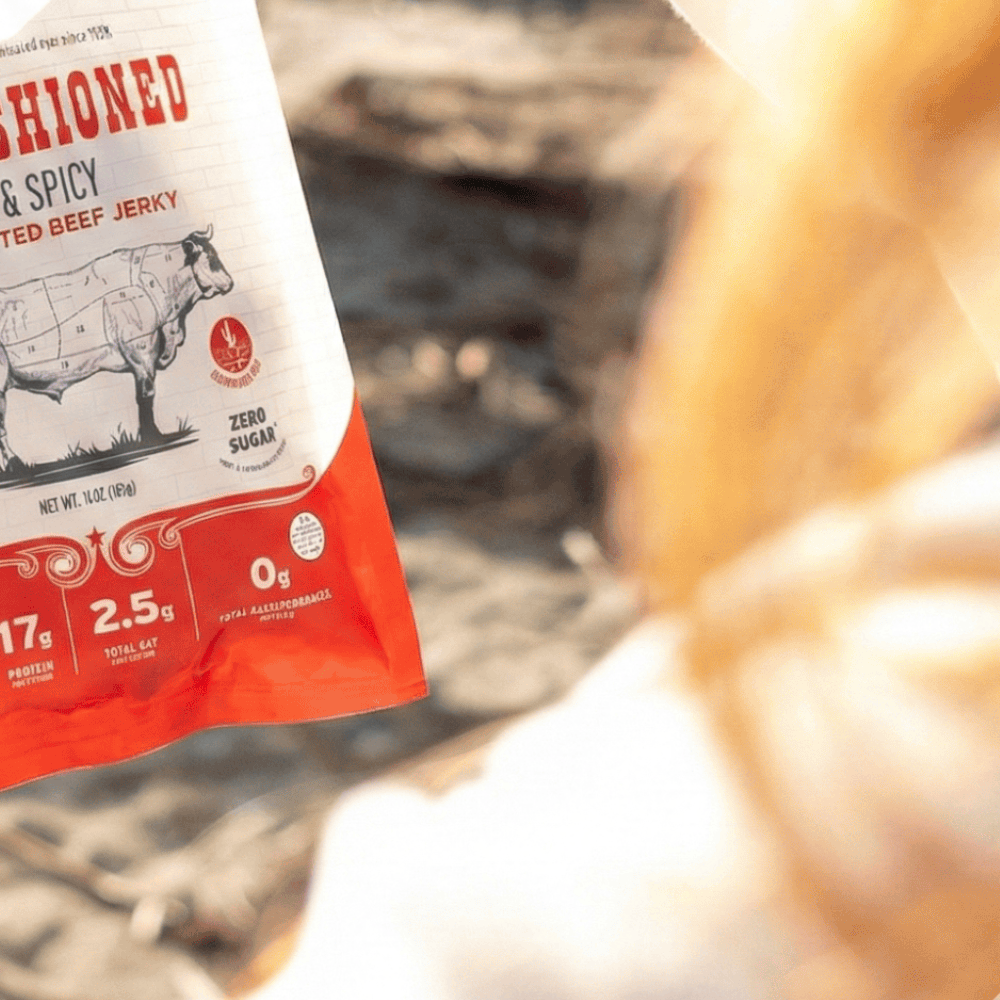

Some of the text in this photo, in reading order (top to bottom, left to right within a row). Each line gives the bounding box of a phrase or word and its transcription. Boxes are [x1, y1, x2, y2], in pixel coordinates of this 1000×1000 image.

[0, 178, 22, 218] &
[25, 157, 100, 212] SPICY
[49, 206, 105, 238] BEEF
[112, 190, 179, 222] JERKY
[228, 406, 267, 432] ZERO
[39, 497, 59, 515] NET
[60, 492, 82, 511] WT.
[250, 556, 291, 590] 0g
[89, 589, 175, 635] 2.5g
